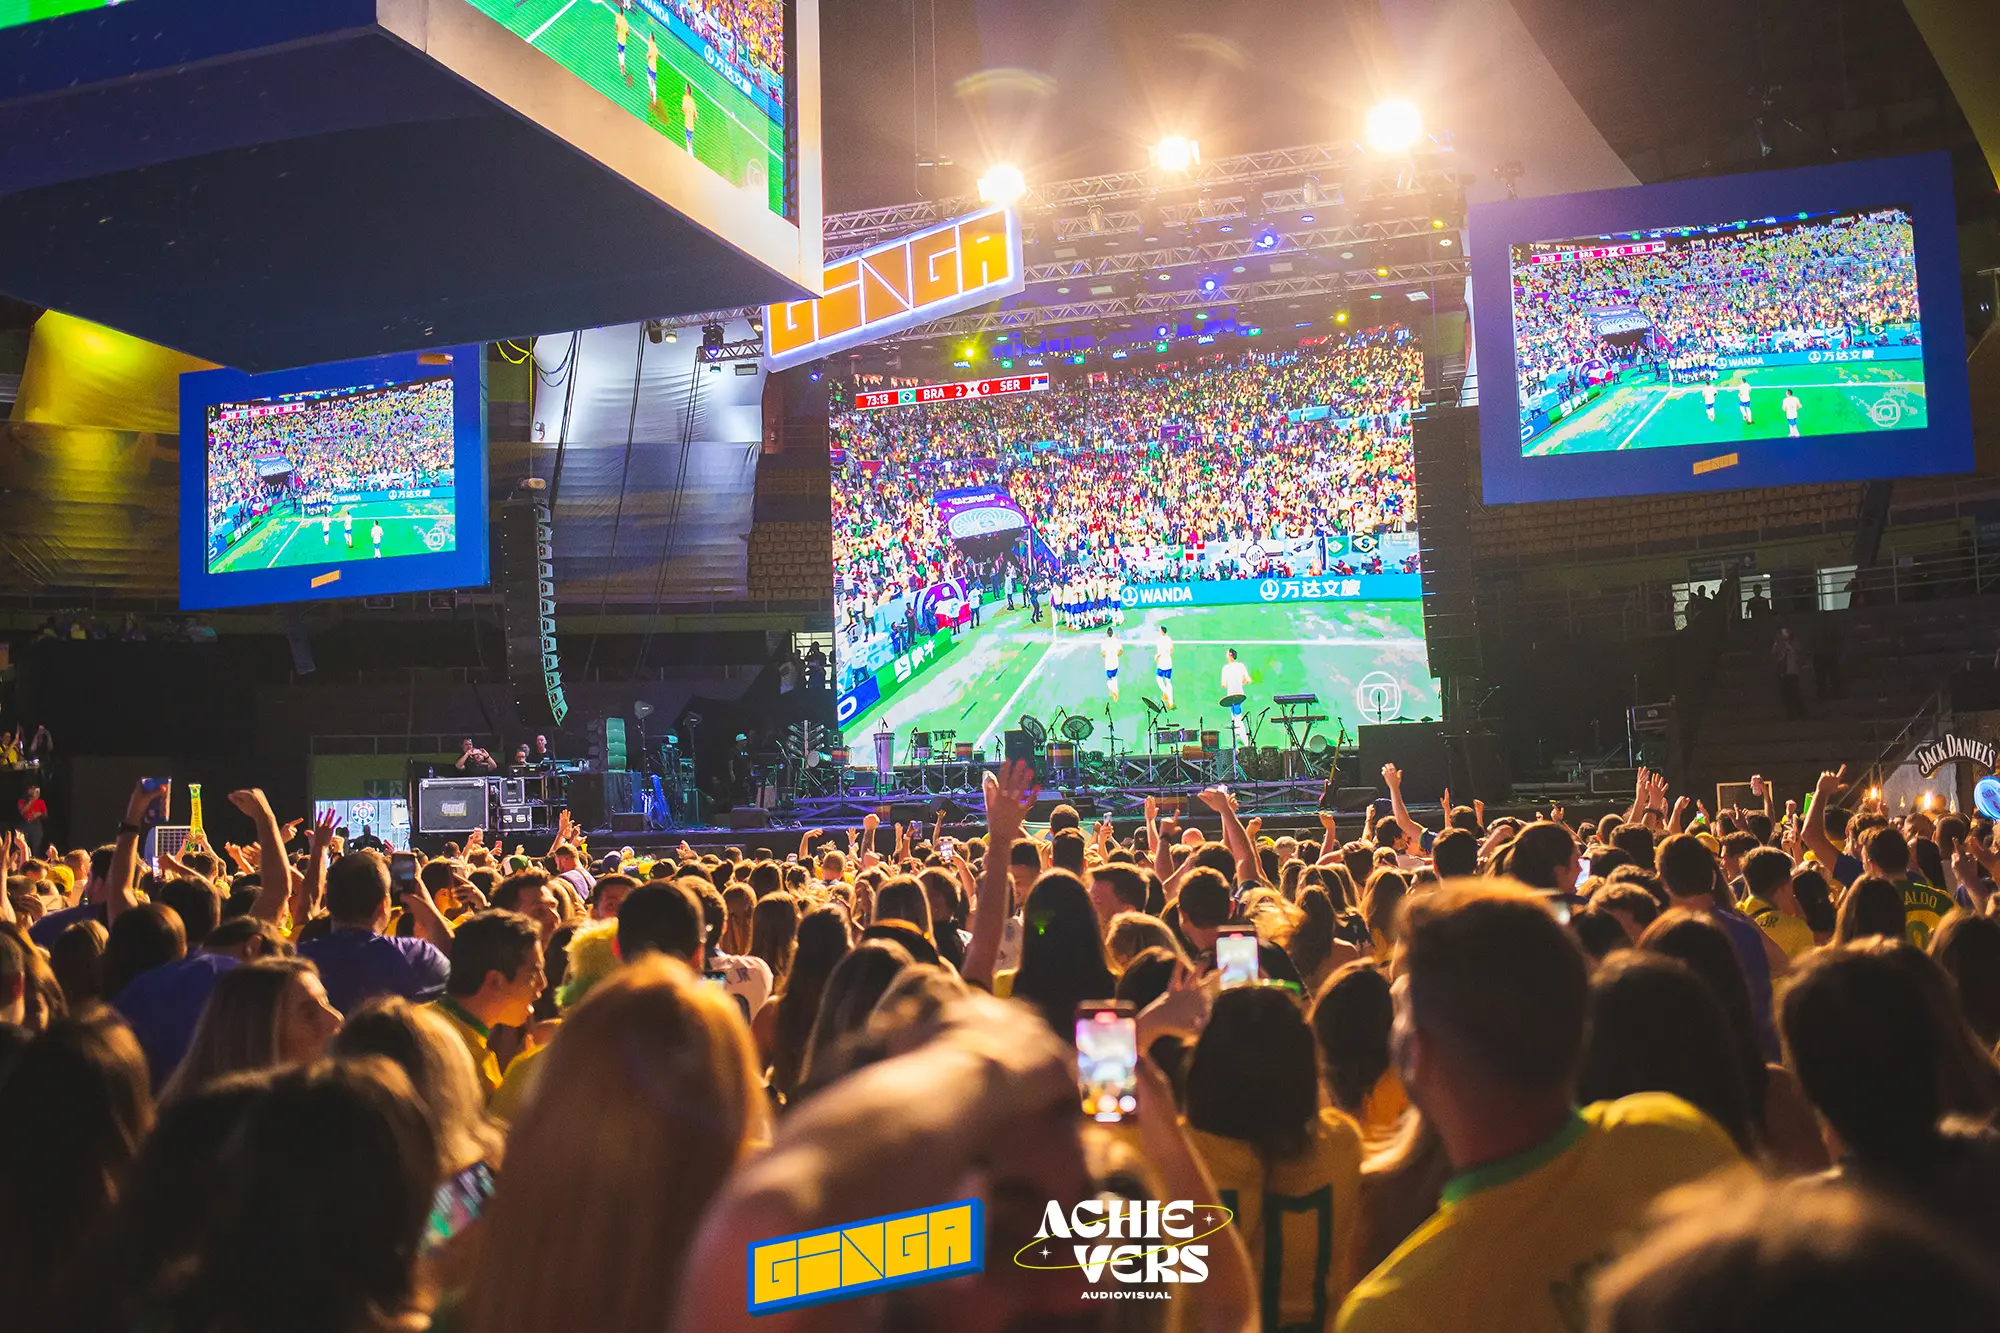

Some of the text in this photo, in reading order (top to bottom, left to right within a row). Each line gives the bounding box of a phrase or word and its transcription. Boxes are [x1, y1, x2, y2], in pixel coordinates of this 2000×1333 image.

[769, 209, 1010, 357] GINGA
[1728, 356, 1764, 367] WANDA
[866, 379, 1021, 406] 73:13 BRA 2 0 SER
[1139, 586, 1193, 603] WANDA
[1918, 734, 1996, 774] JACK DANIEL'S
[1904, 891, 1937, 909] ALDO
